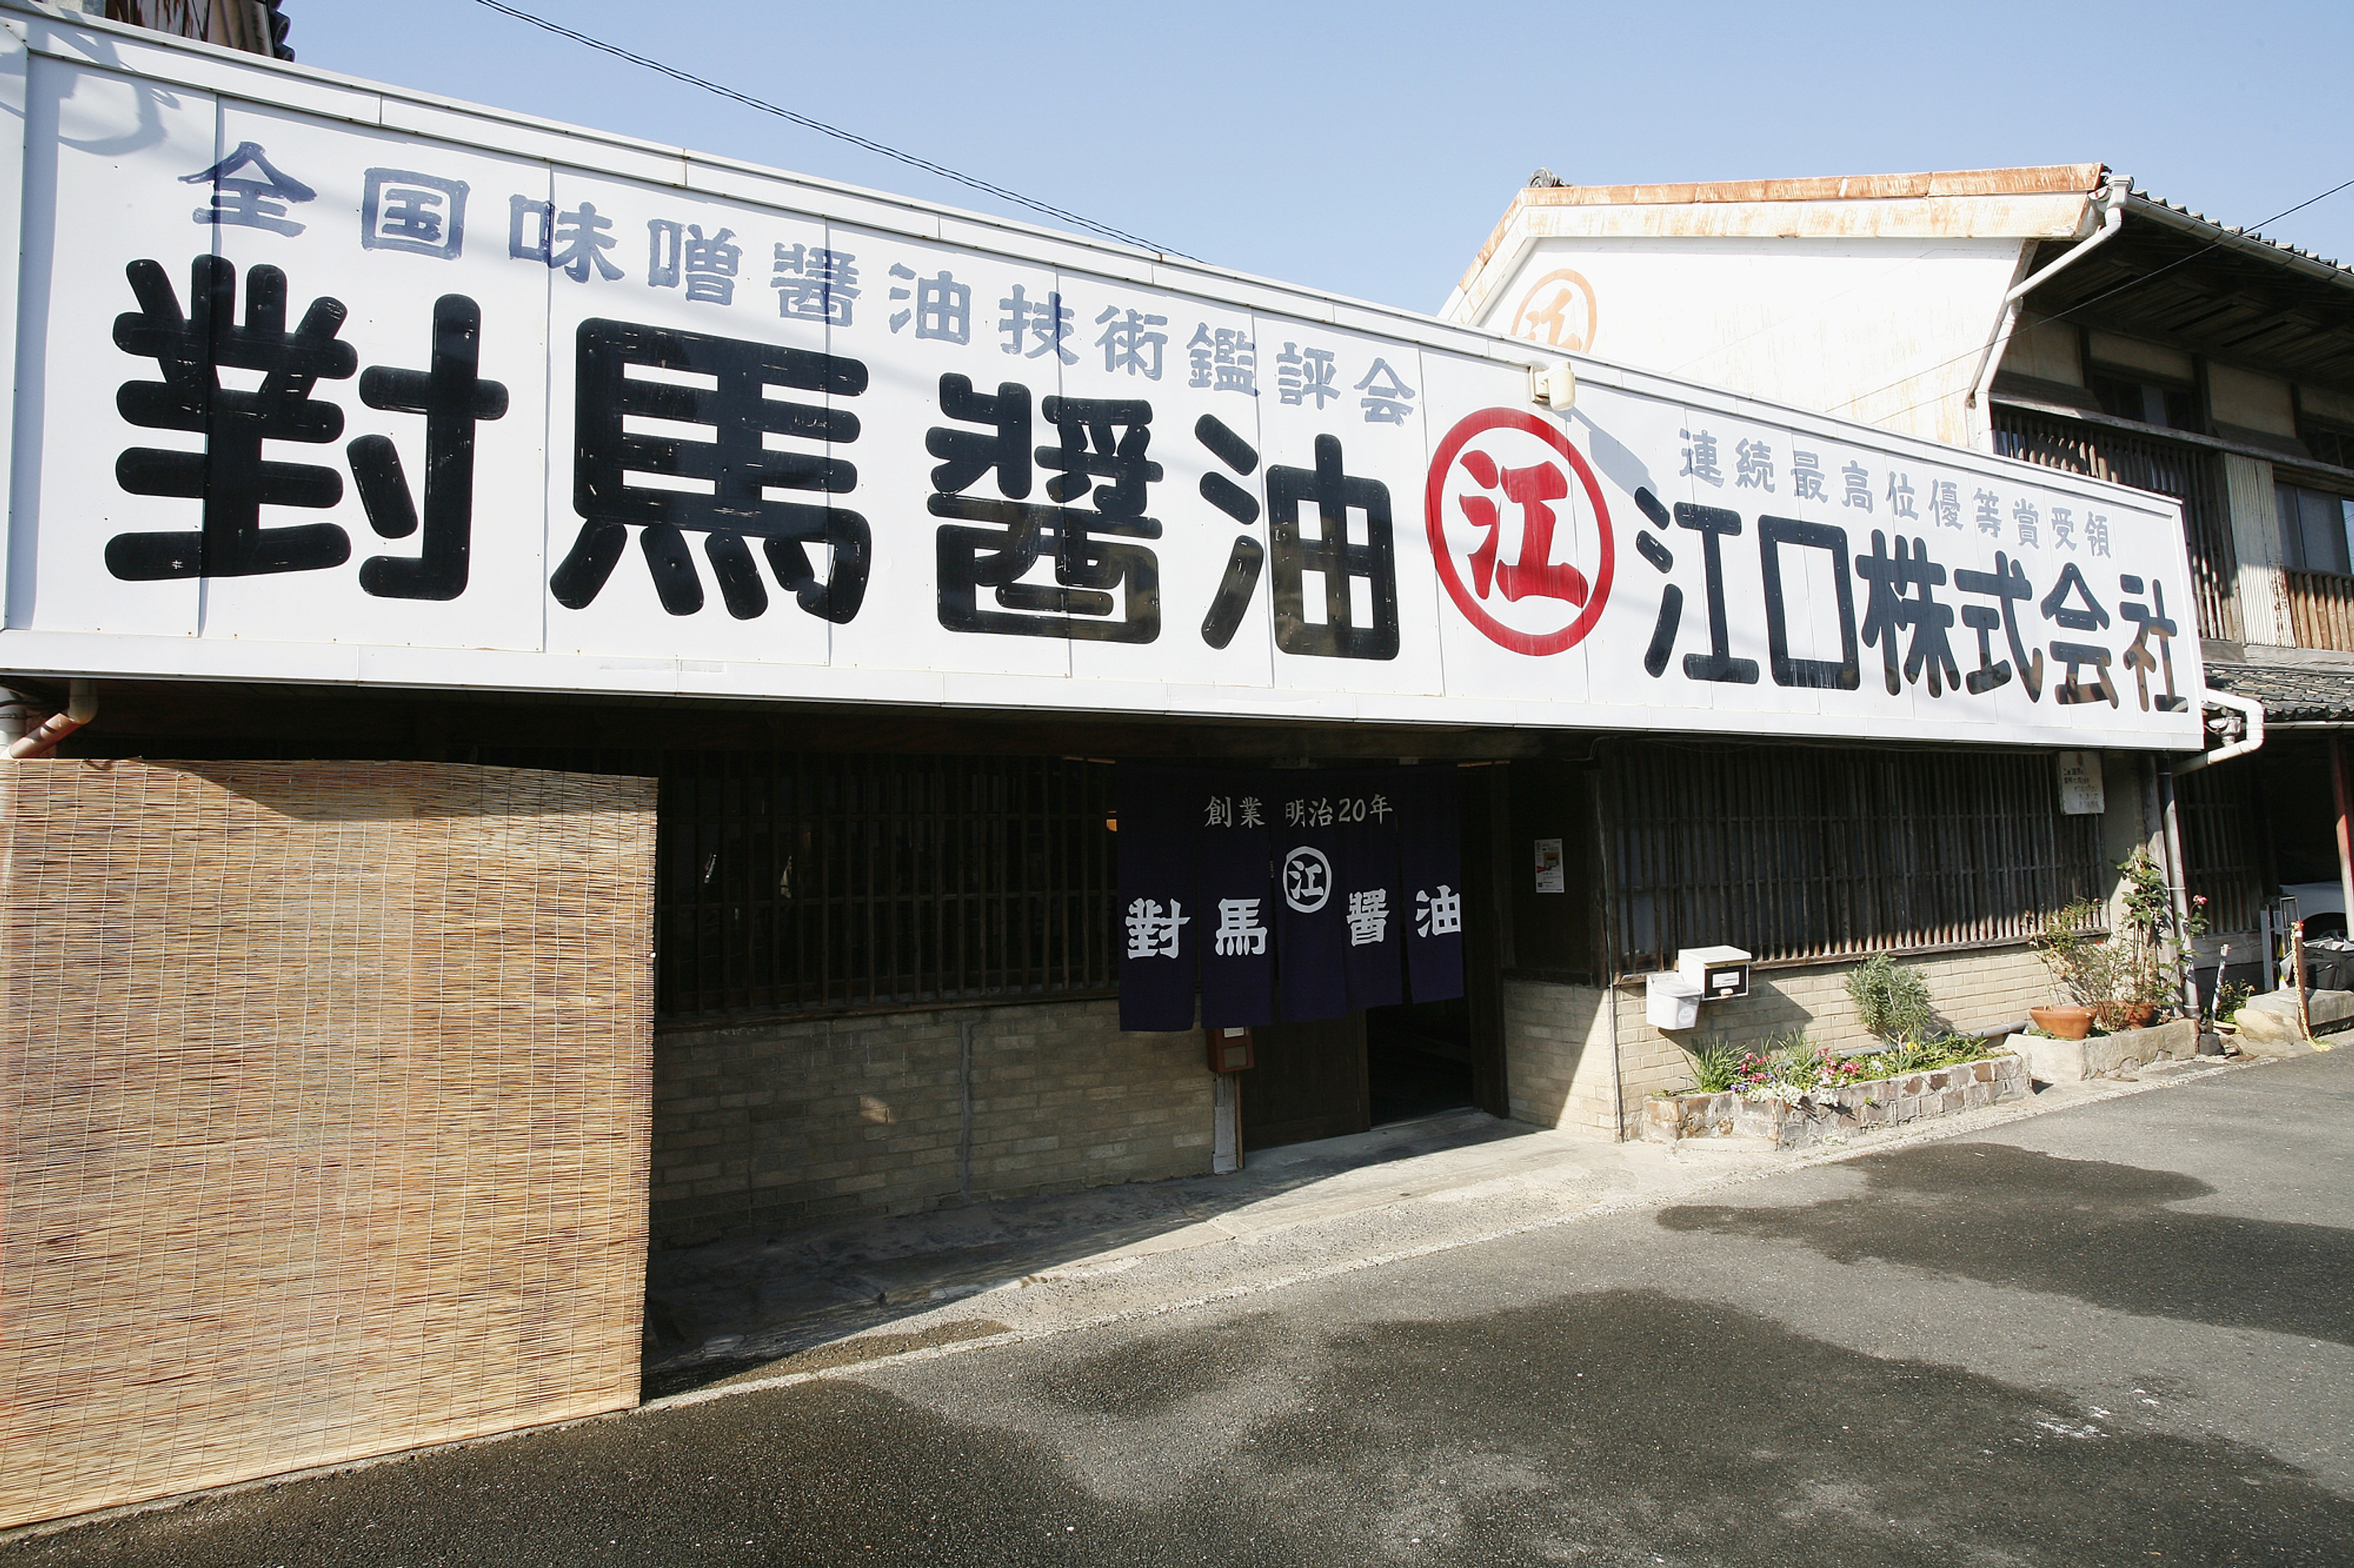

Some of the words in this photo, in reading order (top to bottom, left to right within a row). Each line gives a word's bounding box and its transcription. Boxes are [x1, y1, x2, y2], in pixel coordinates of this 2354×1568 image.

[1460, 450, 1588, 609] 江
[1678, 428, 2112, 558] 連続最高位優等賞受領
[1634, 486, 2189, 713] 江口株式会社
[1204, 795, 1265, 829] 創業
[1285, 794, 1394, 827] 明治20年
